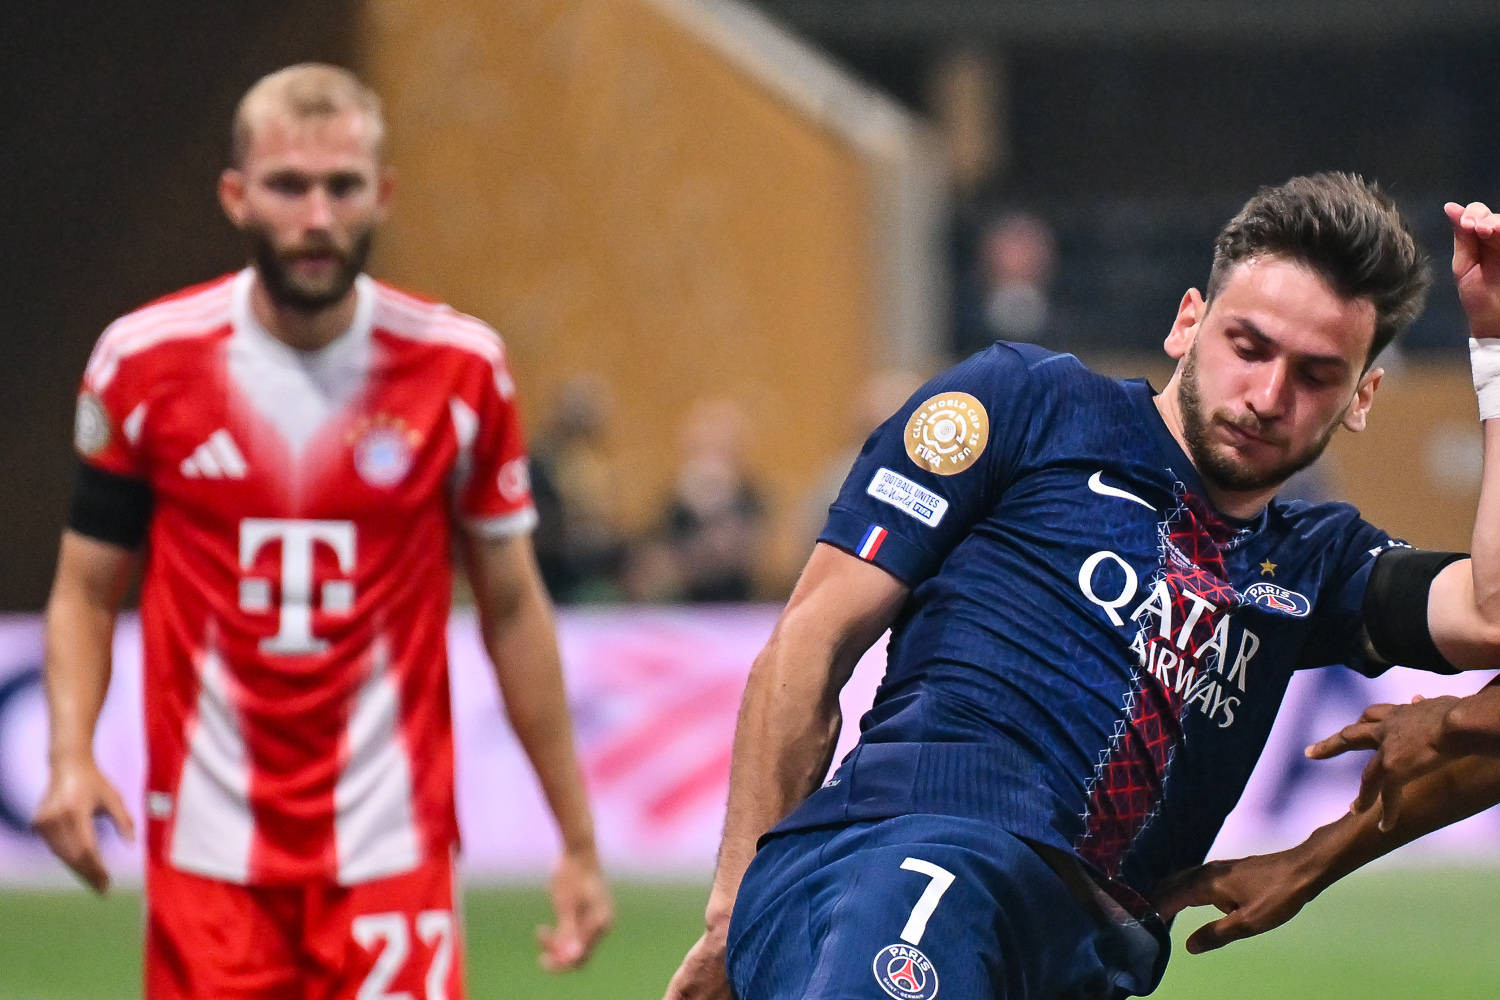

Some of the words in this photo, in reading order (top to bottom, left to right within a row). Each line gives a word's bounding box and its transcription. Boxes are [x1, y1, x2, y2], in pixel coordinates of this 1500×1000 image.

[913, 412, 928, 438] CLUB
[928, 399, 967, 412] WORLD
[967, 409, 980, 429] CUP
[914, 443, 942, 468] FIFA
[950, 447, 972, 464] USA
[882, 472, 914, 495] FOOTBALL
[914, 488, 940, 509] UNITES
[888, 487, 914, 508] World
[1249, 585, 1290, 598] PARIS
[1078, 550, 1260, 692] QATAR
[1129, 631, 1241, 728] AIRWAYS
[899, 857, 956, 946] 7
[888, 947, 931, 972] PARIS
